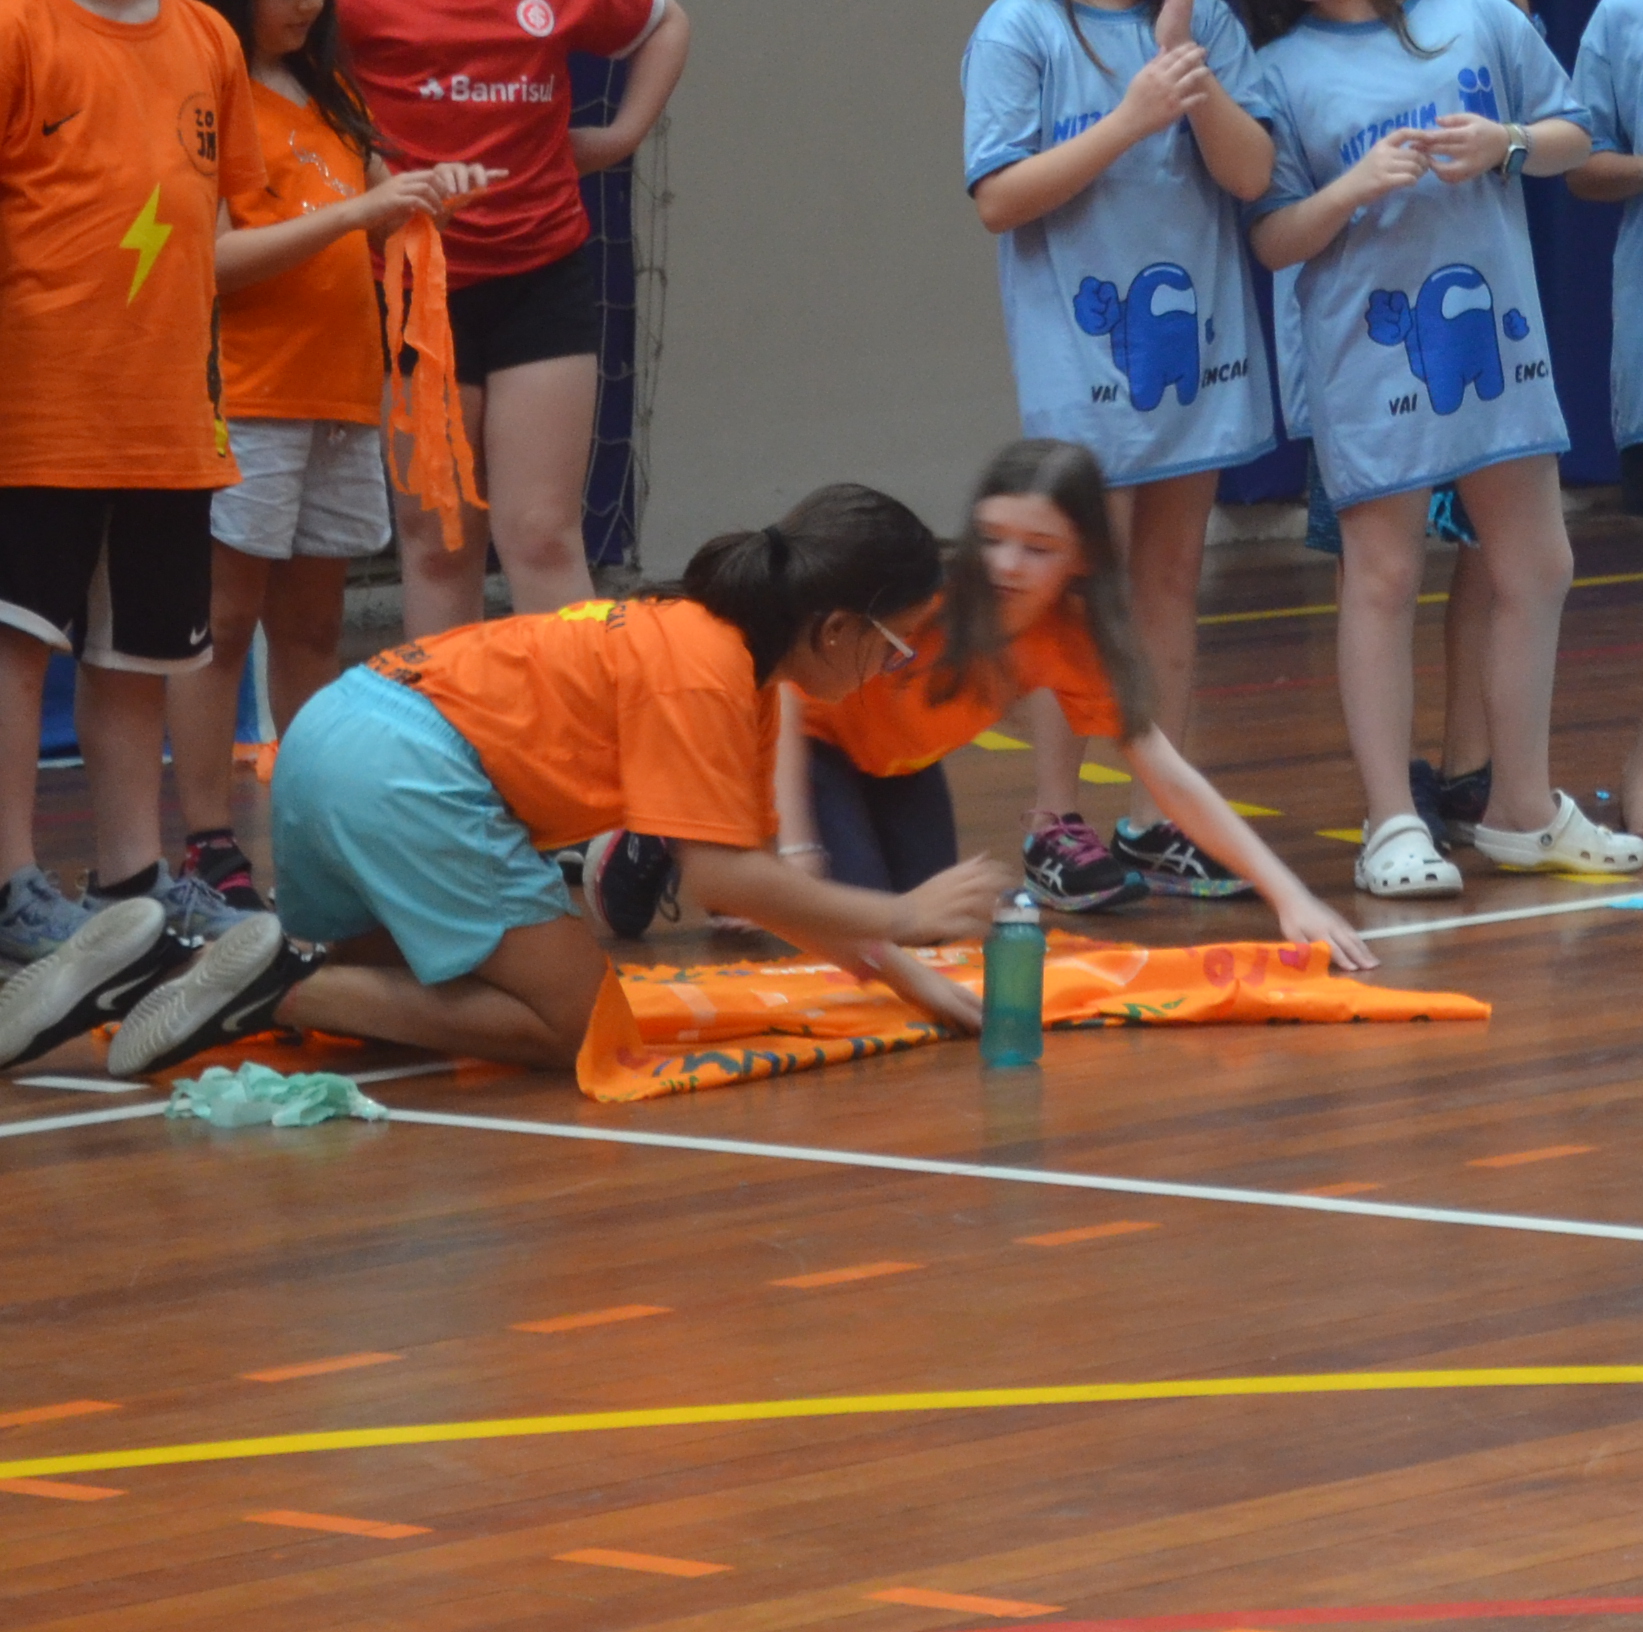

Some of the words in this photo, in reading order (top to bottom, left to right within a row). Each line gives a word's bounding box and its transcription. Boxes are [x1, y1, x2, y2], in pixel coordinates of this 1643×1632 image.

[450, 74, 555, 103] Banrisul
[1092, 384, 1119, 403] VAI
[1389, 392, 1418, 416] VAI
